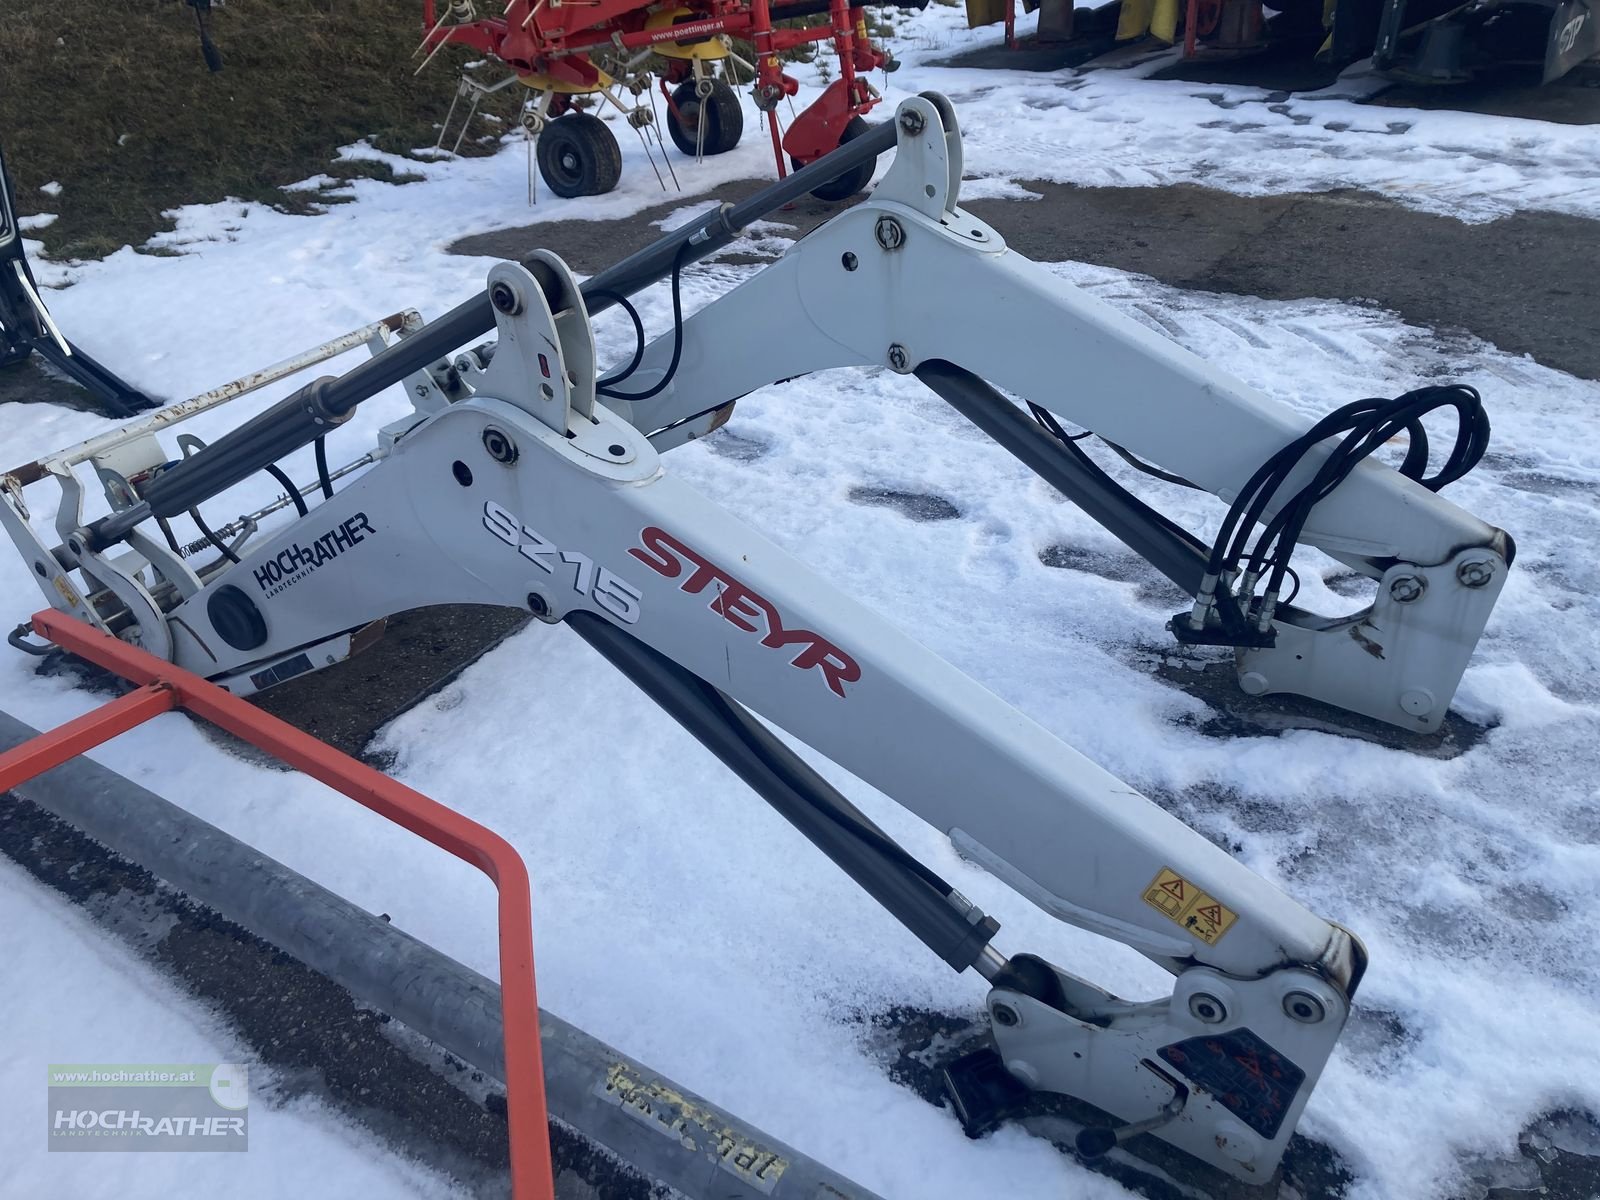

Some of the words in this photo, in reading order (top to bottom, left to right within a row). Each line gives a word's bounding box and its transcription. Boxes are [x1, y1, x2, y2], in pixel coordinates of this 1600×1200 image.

[651, 20, 724, 41] www.poettinger.at
[252, 511, 377, 591] HOCHRATHER
[265, 564, 316, 600] LANDTECHNIK
[482, 500, 643, 625] SZ15
[624, 526, 862, 699] STEYR
